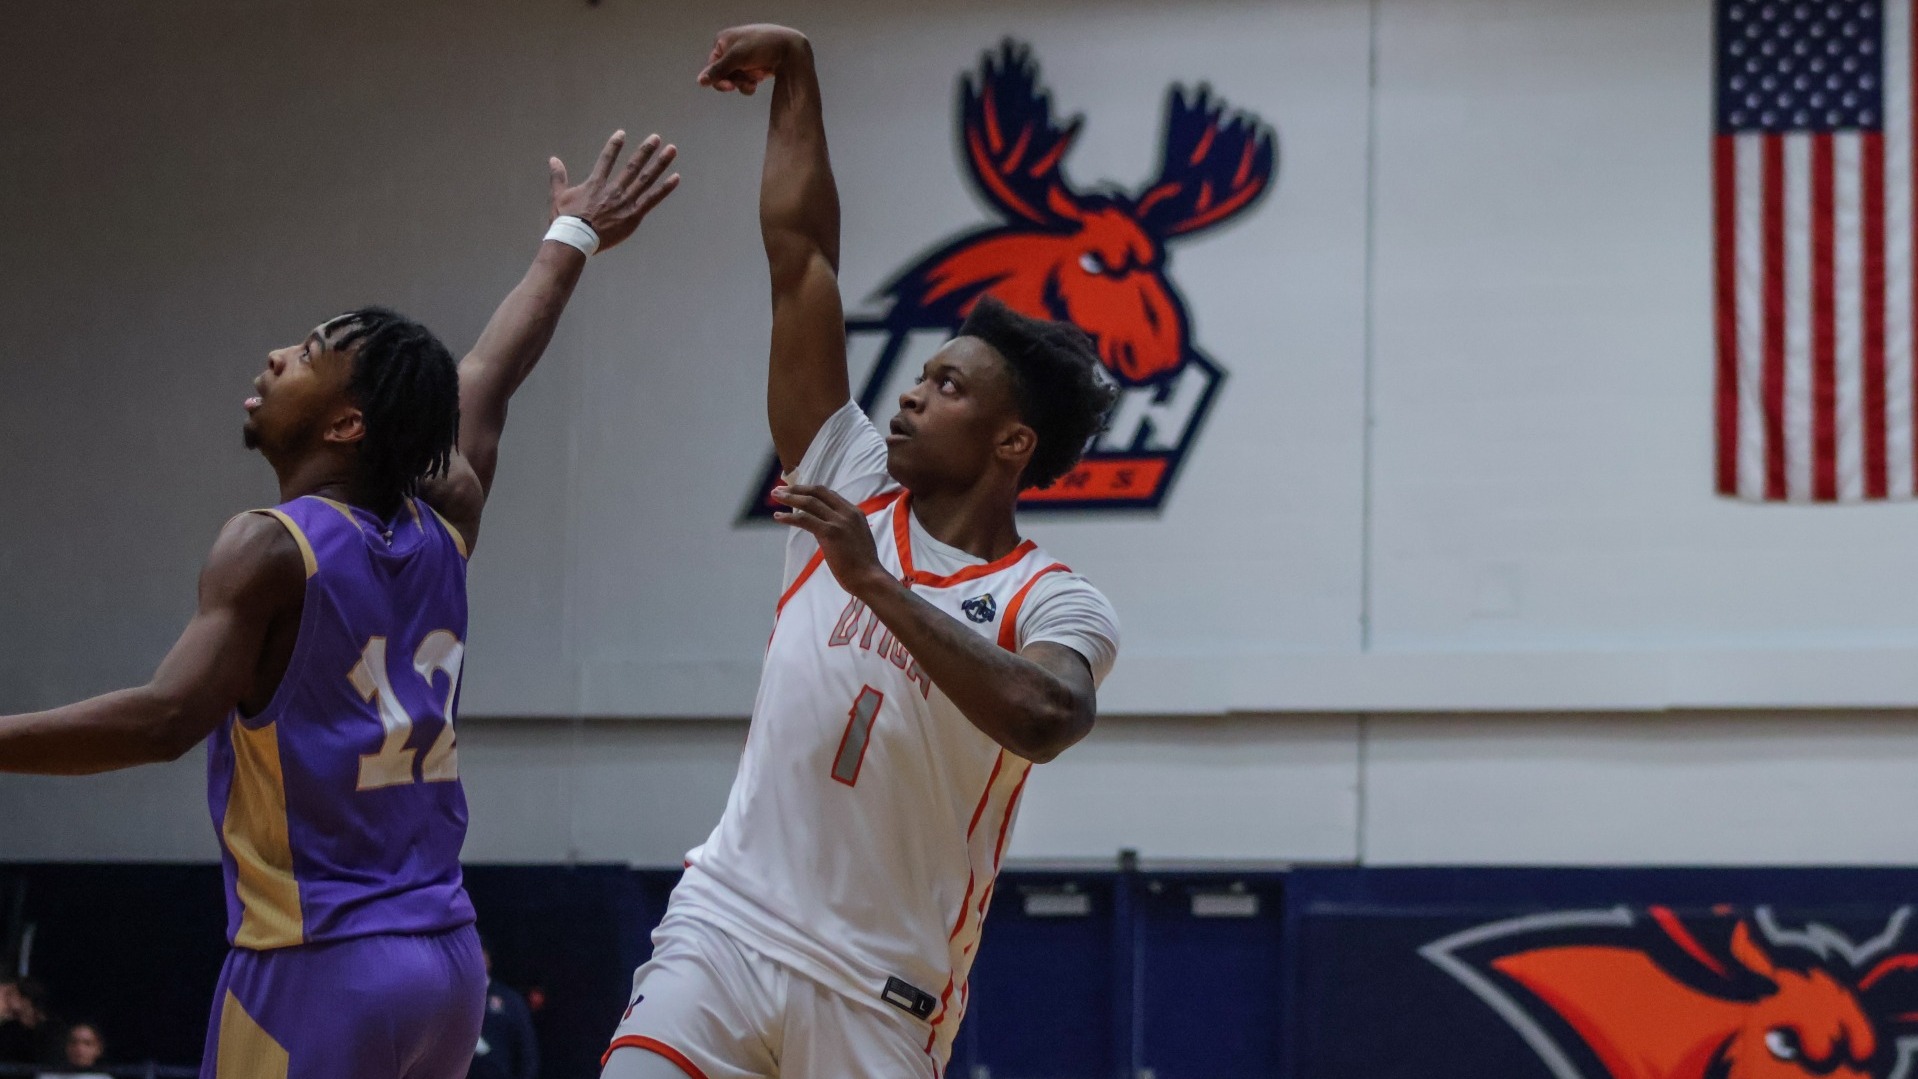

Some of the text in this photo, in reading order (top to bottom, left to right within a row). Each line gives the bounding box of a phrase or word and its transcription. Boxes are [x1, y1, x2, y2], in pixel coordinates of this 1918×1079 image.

[346, 629, 464, 791] 12
[831, 684, 884, 787] 1
[919, 999, 926, 1012] L
